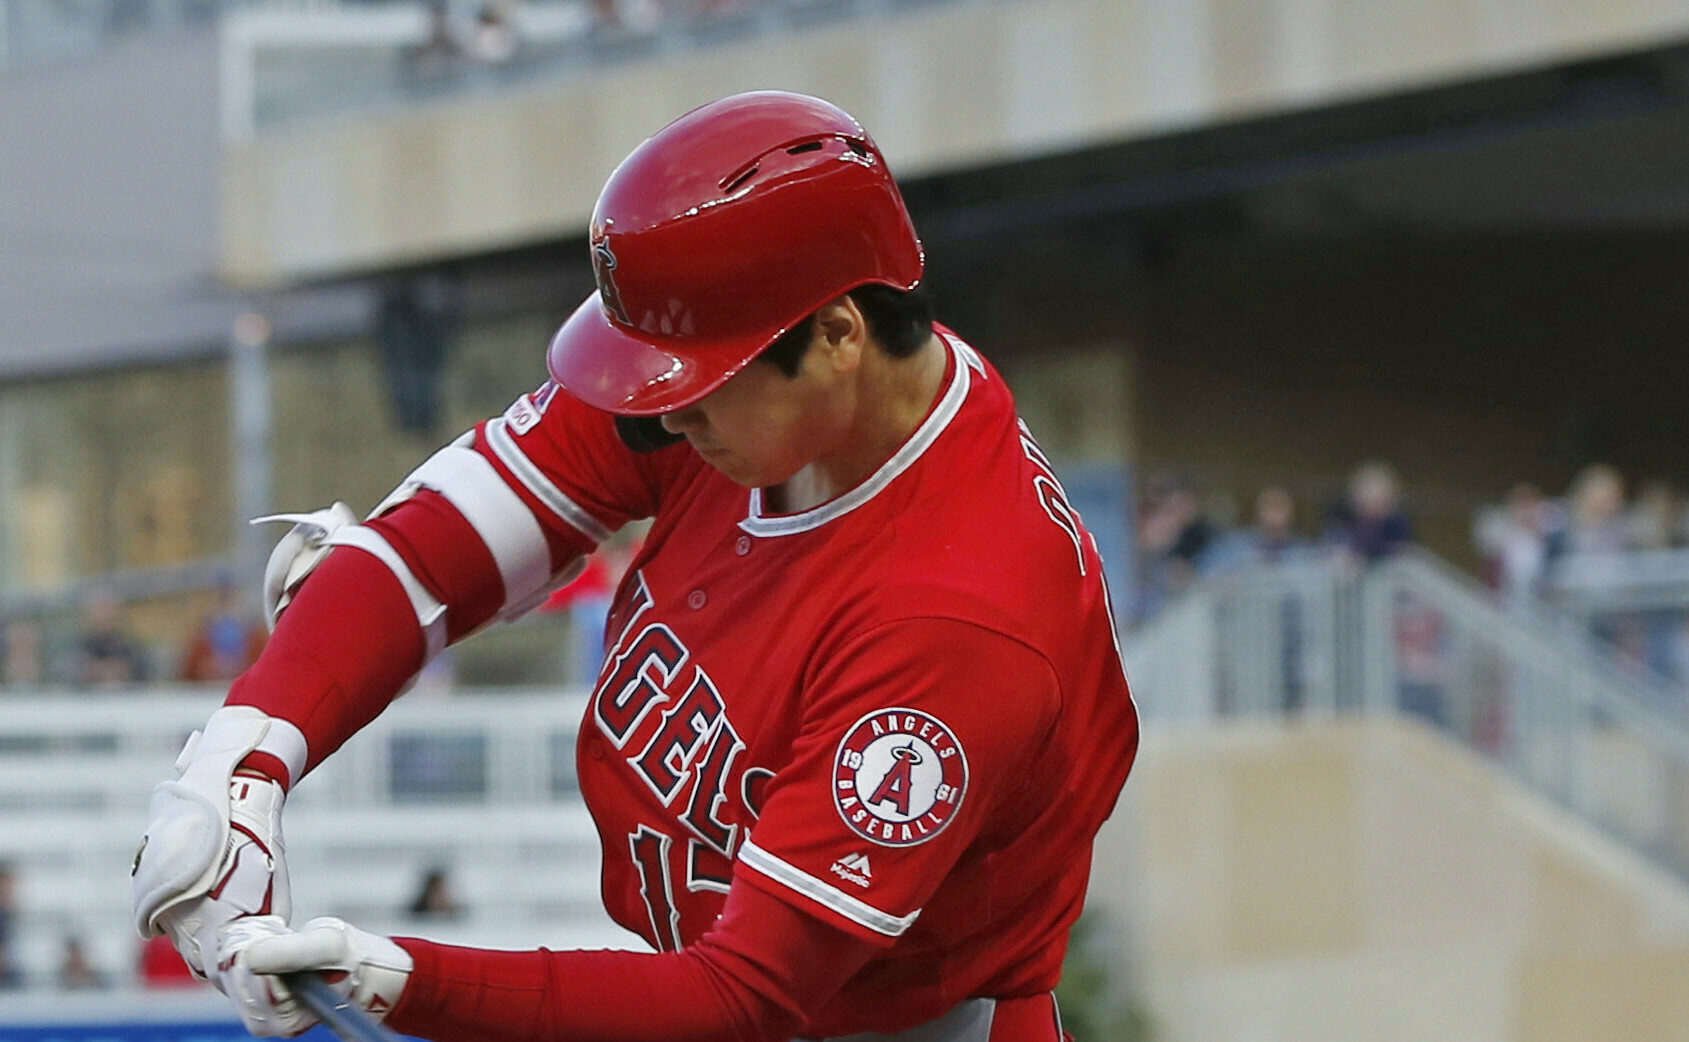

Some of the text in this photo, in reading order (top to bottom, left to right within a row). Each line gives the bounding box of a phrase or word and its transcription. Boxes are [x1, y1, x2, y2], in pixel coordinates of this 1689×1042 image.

[841, 748, 865, 771] 19
[870, 714, 956, 760] ANGELS
[866, 739, 924, 817] A
[837, 779, 943, 841] BASEBALL
[830, 861, 871, 889] Majestic
